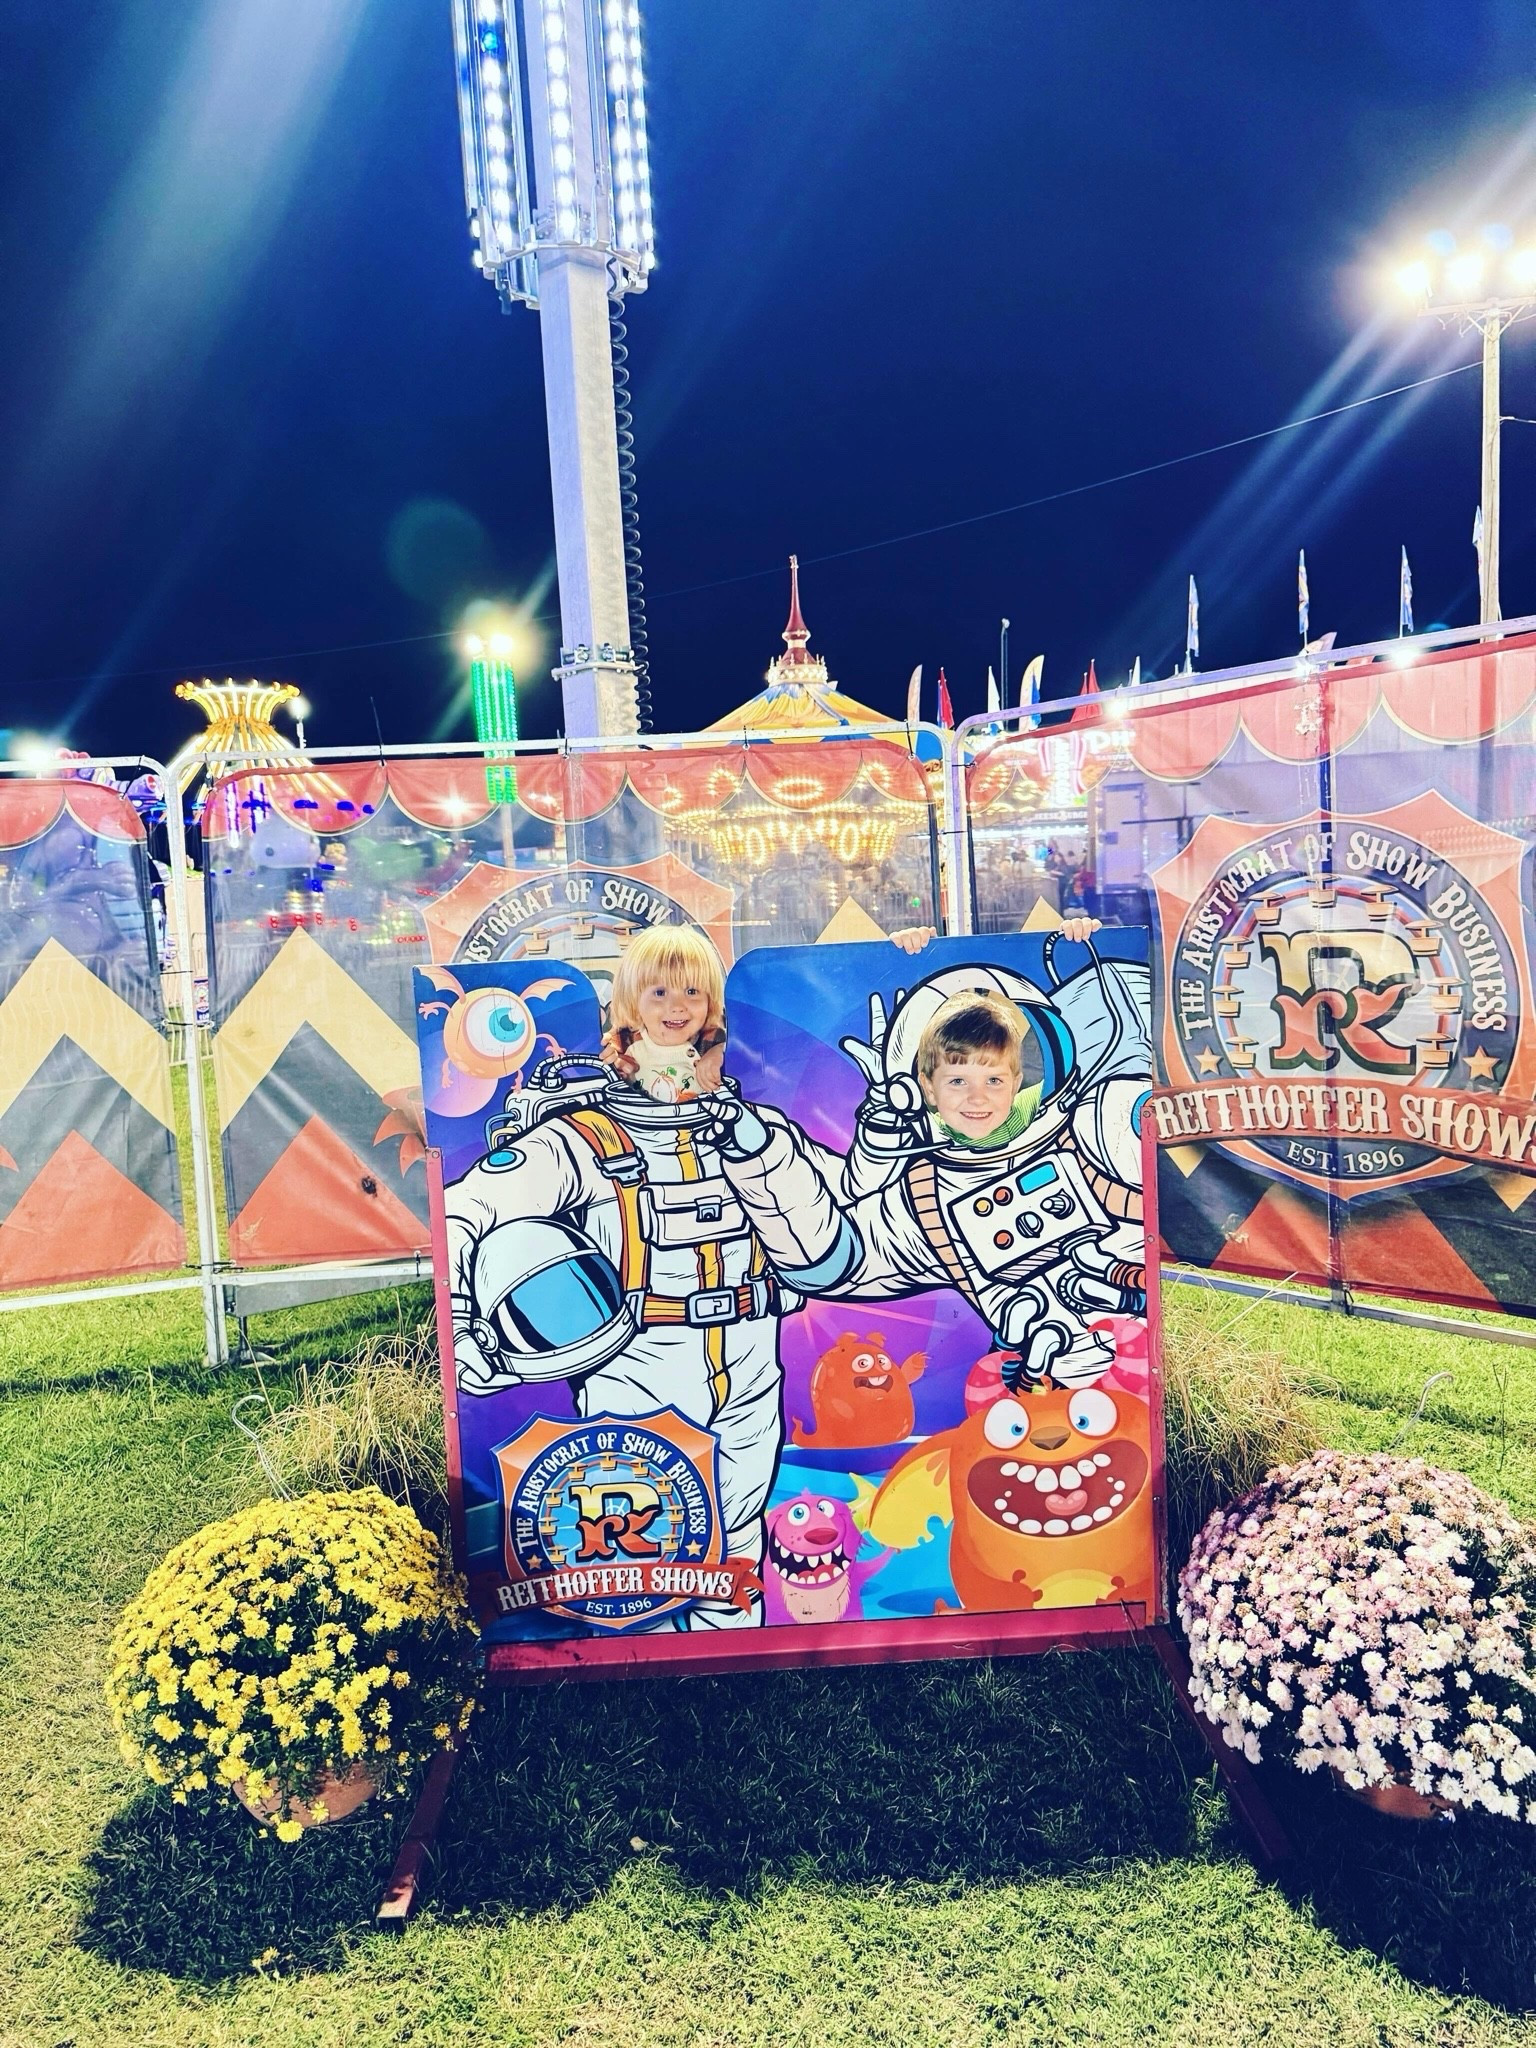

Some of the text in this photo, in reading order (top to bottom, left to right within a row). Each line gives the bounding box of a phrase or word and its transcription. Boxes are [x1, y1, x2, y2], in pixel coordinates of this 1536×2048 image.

[460, 879, 674, 962] ISTOCRAT OF SHOW
[1180, 831, 1508, 1041] THE ARISTOCRAT OF SHOW BUSINESS
[1152, 1084, 1536, 1164] REITHOFFER SHOW
[1286, 1140, 1405, 1174] EST. 1896
[515, 1432, 707, 1554] THE ARISTOCRAT OF SHOW BUSINESS
[497, 1567, 735, 1612] REITHOFFER SHOWS
[585, 1598, 652, 1616] EST. 1896
